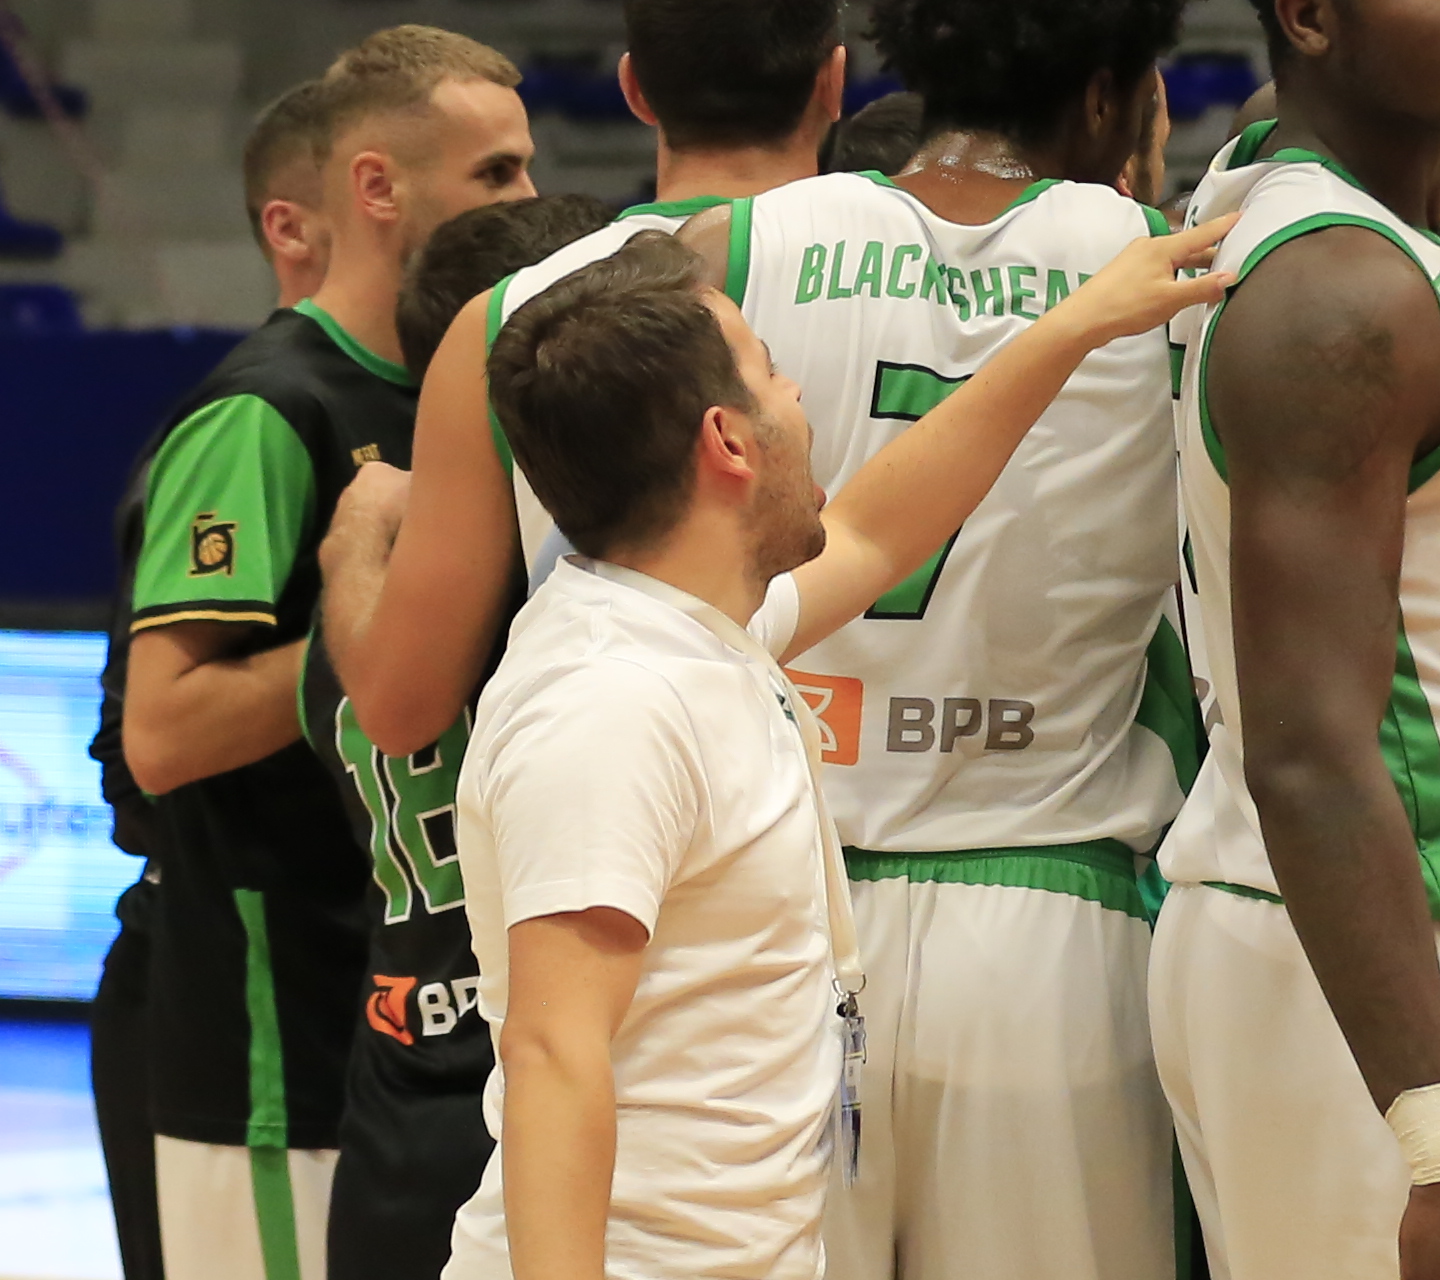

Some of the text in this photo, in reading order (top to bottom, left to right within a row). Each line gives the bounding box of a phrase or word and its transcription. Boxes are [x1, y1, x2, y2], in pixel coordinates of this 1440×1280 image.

[795, 240, 1093, 321] BLACKSHEA
[886, 696, 1035, 753] BPB
[417, 976, 480, 1036] BP
